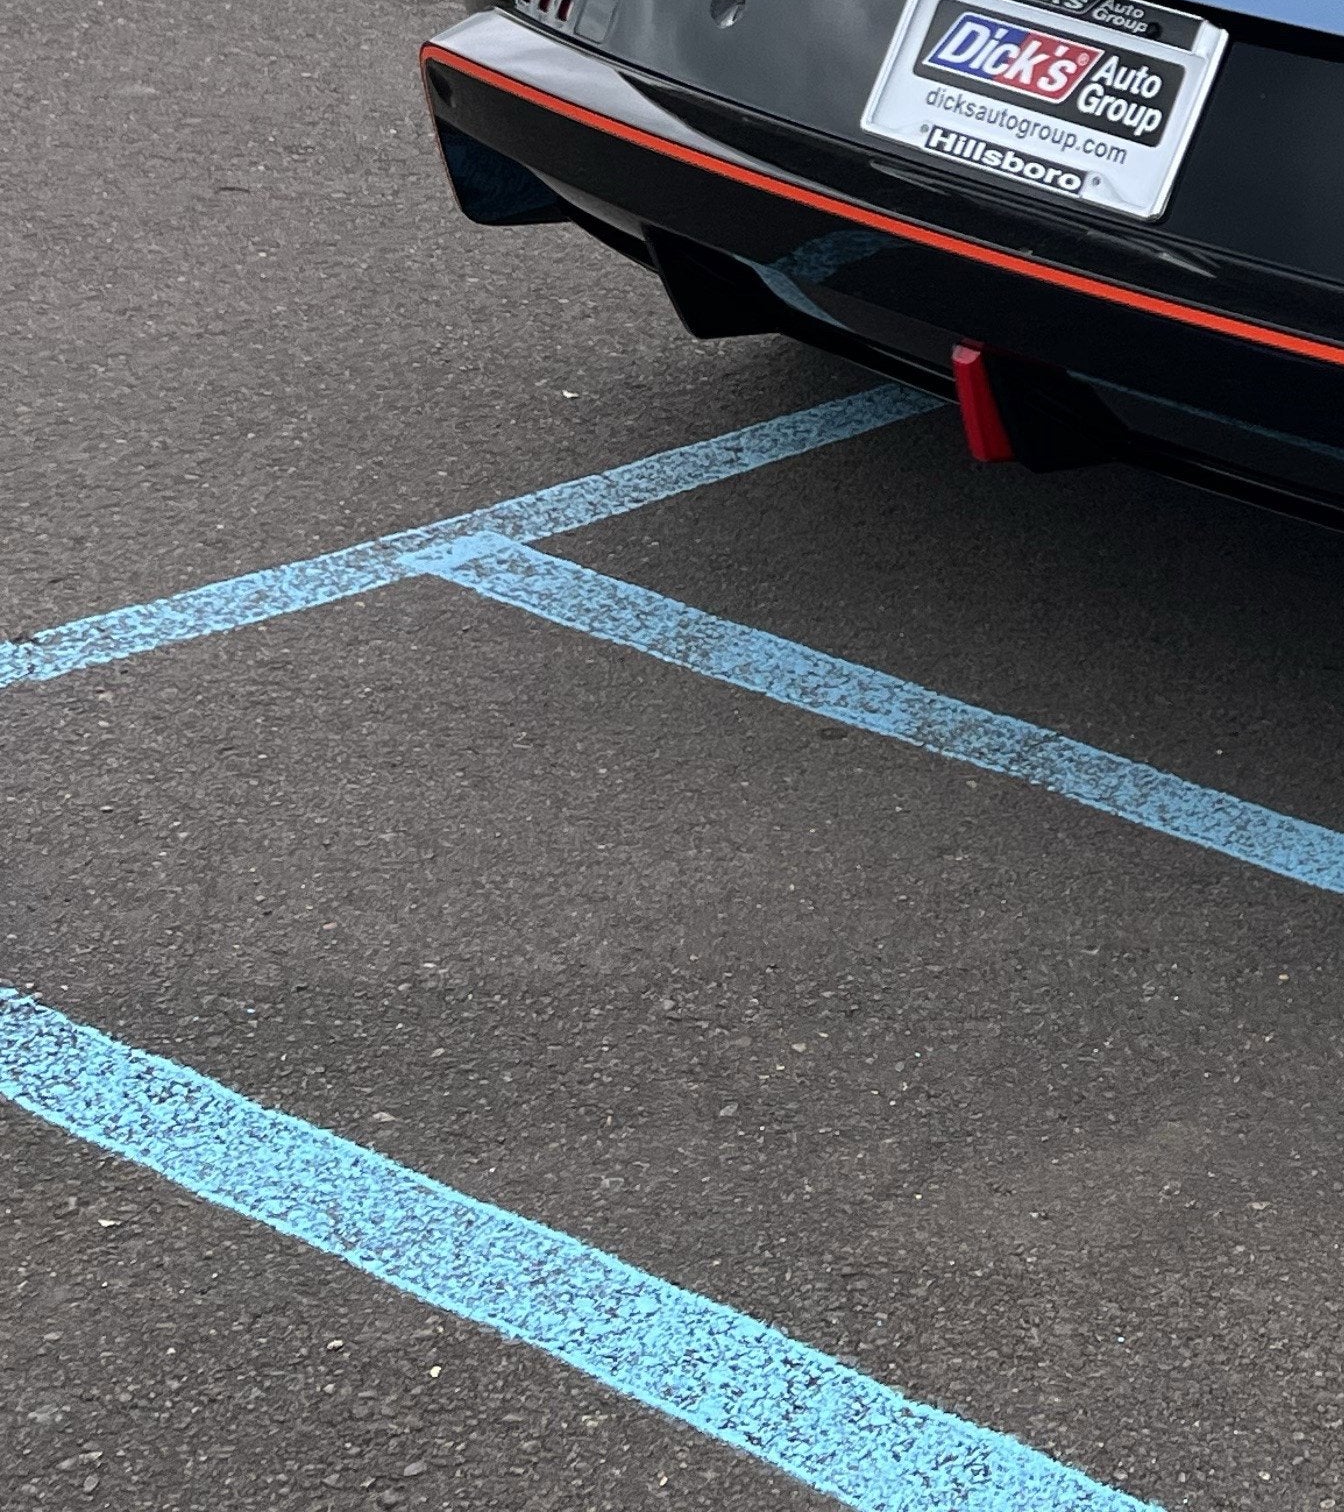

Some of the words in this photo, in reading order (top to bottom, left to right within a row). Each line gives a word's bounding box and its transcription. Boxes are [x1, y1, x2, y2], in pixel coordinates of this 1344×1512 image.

[1091, 8, 1149, 34] Group
[937, 20, 1078, 93] Dick's
[1091, 55, 1163, 99] Auto
[925, 86, 1128, 165] dicksautogroup.com
[1076, 84, 1163, 137] Group
[928, 127, 1082, 191] Hillsboro
